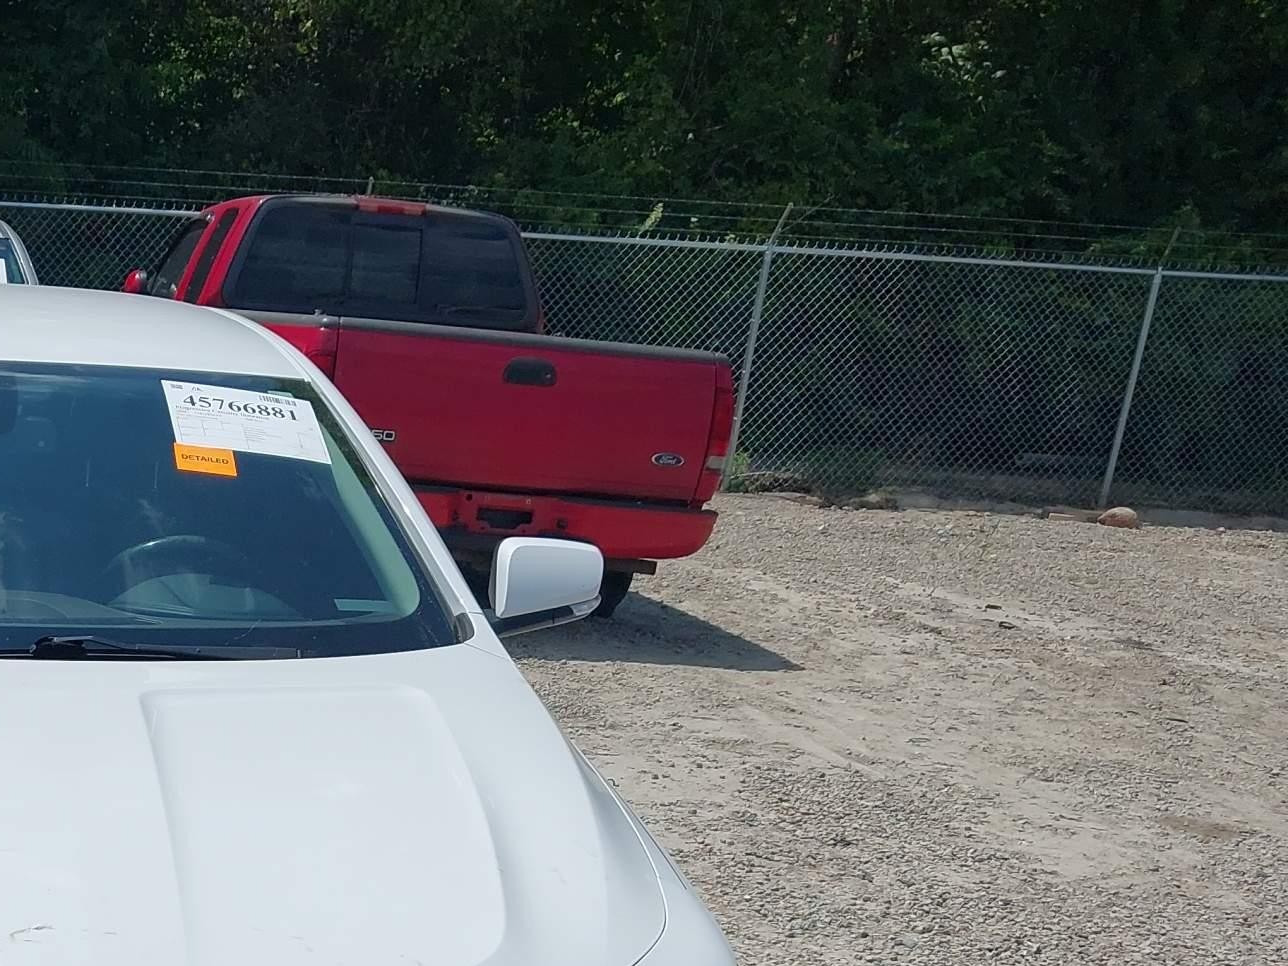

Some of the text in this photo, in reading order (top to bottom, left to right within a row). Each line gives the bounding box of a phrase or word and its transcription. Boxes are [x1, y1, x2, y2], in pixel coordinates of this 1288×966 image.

[183, 394, 298, 421] 45766881
[370, 429, 396, 441] 50
[180, 453, 230, 466] DETAILED
